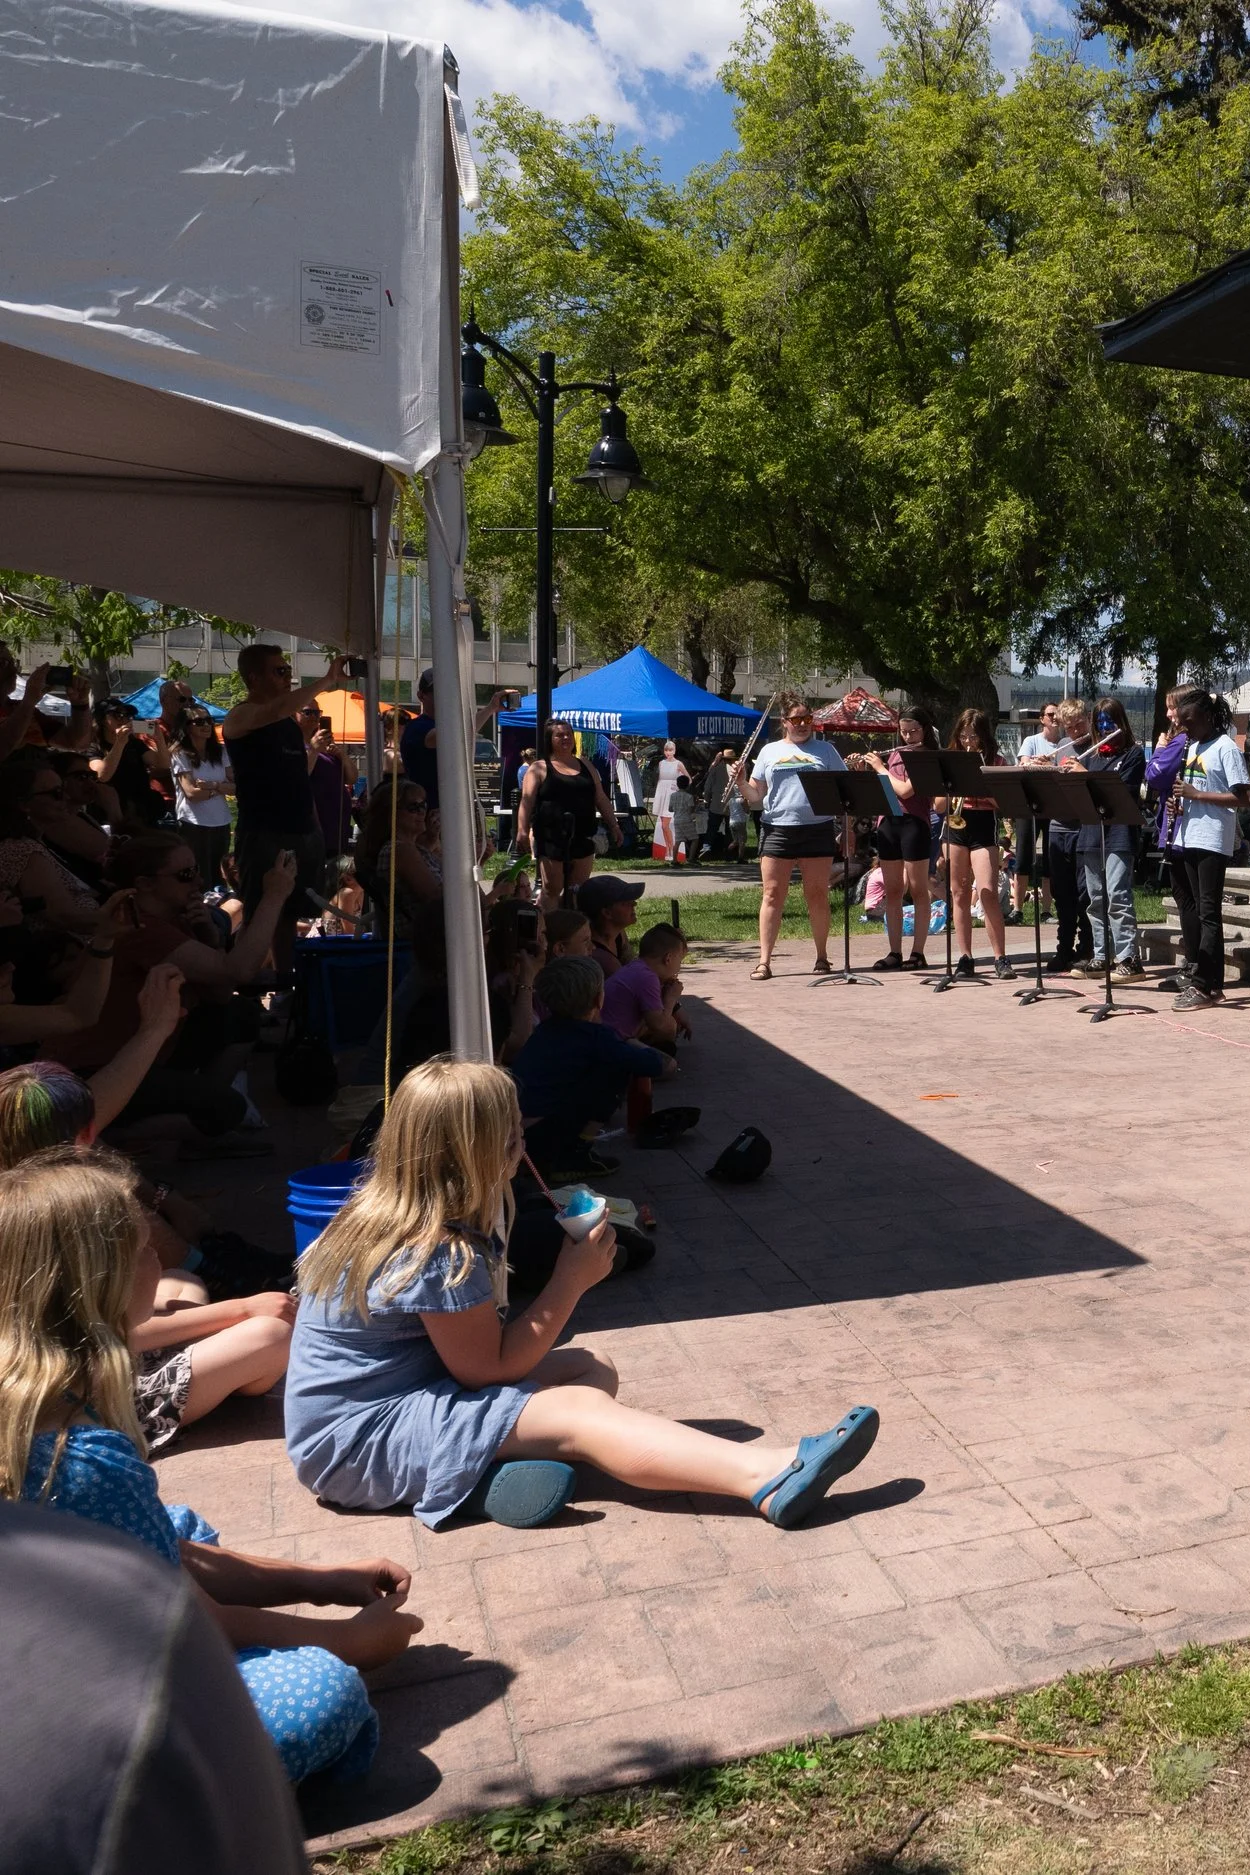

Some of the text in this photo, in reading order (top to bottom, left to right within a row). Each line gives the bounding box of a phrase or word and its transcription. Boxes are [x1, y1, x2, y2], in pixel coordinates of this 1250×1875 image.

[582, 710, 622, 732] THEATRE
[697, 716, 745, 736] KEY CITY THEATRE
